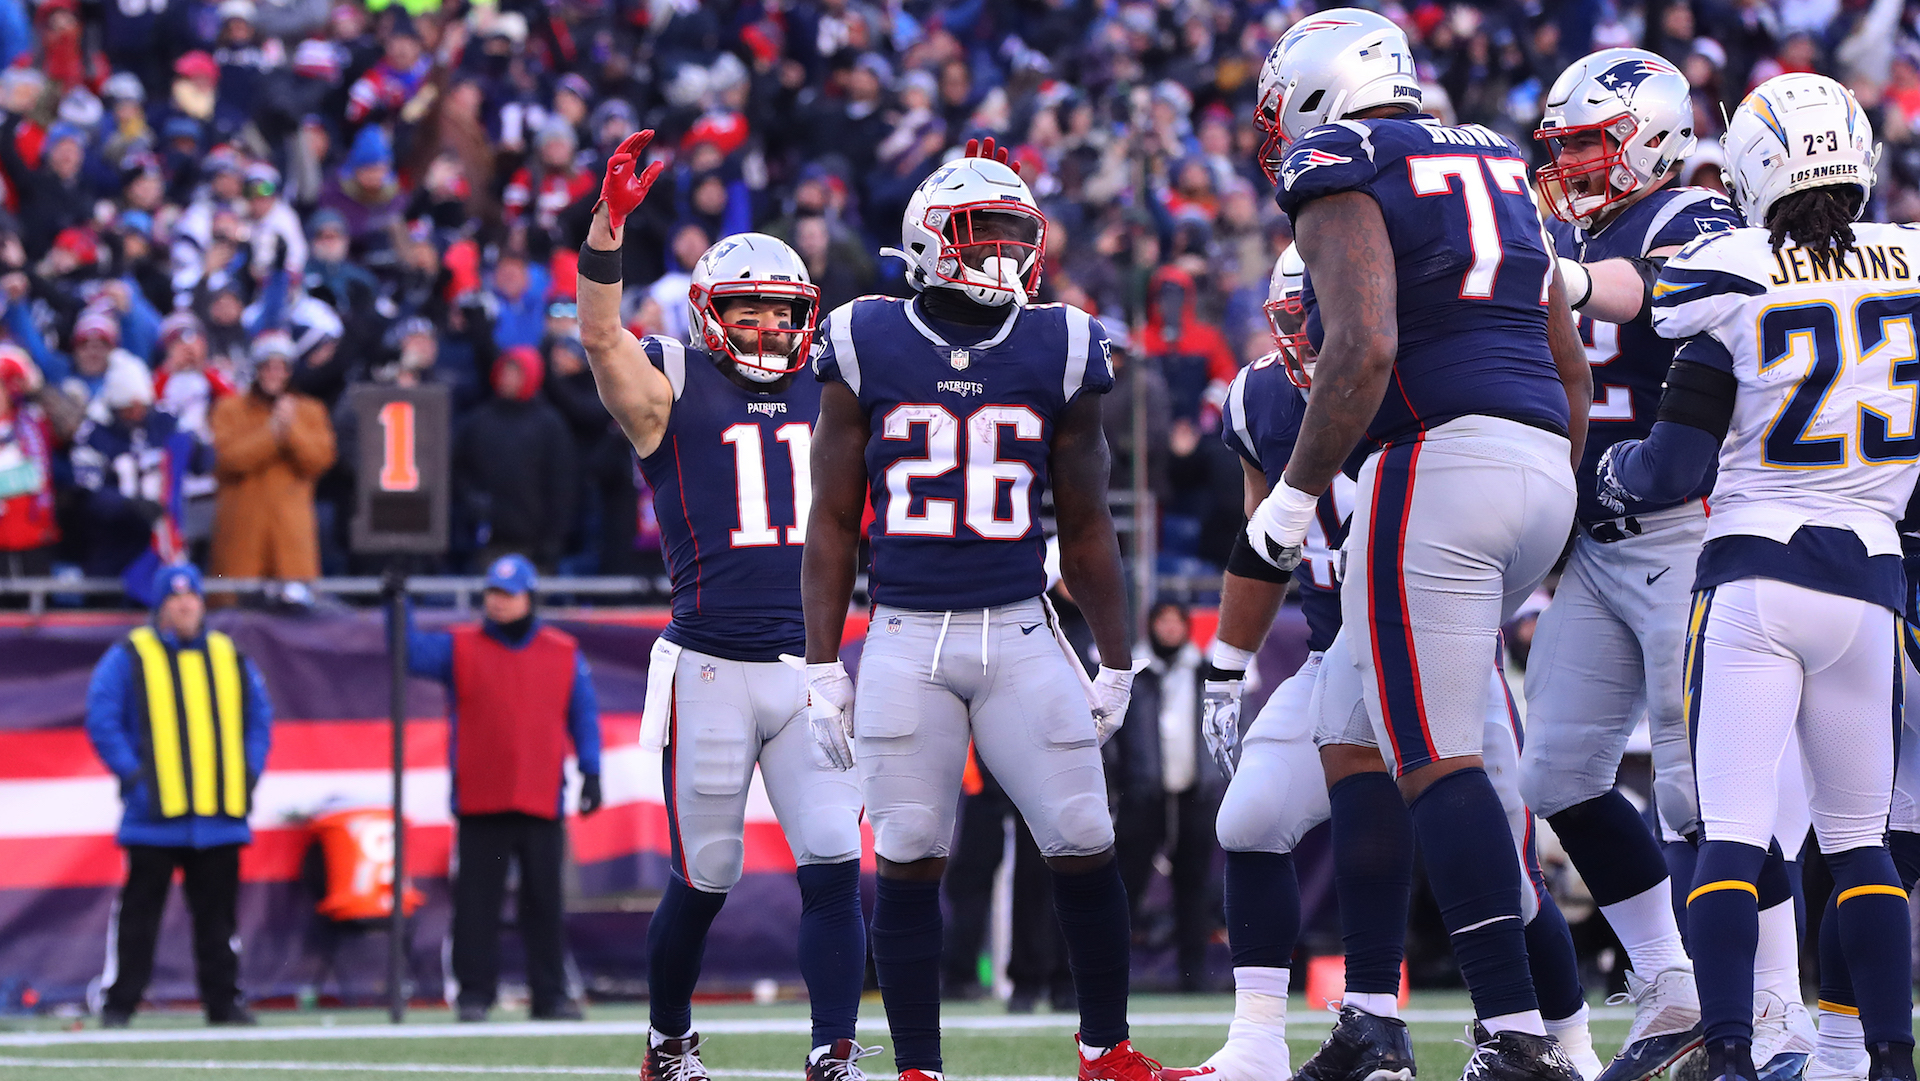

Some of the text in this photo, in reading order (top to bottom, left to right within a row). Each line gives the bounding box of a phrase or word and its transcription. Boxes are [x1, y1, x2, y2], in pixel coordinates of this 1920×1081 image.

[1790, 164, 1858, 184] LOS ANGELES
[1405, 154, 1556, 305] 77
[1769, 245, 1911, 287] JENKINS
[747, 403, 787, 414] PATRIOTS
[937, 381, 984, 396] PATRIOTS
[1755, 289, 1920, 470] 23
[378, 401, 419, 489] 1
[720, 422, 812, 549] 11
[882, 402, 1045, 540] 26
